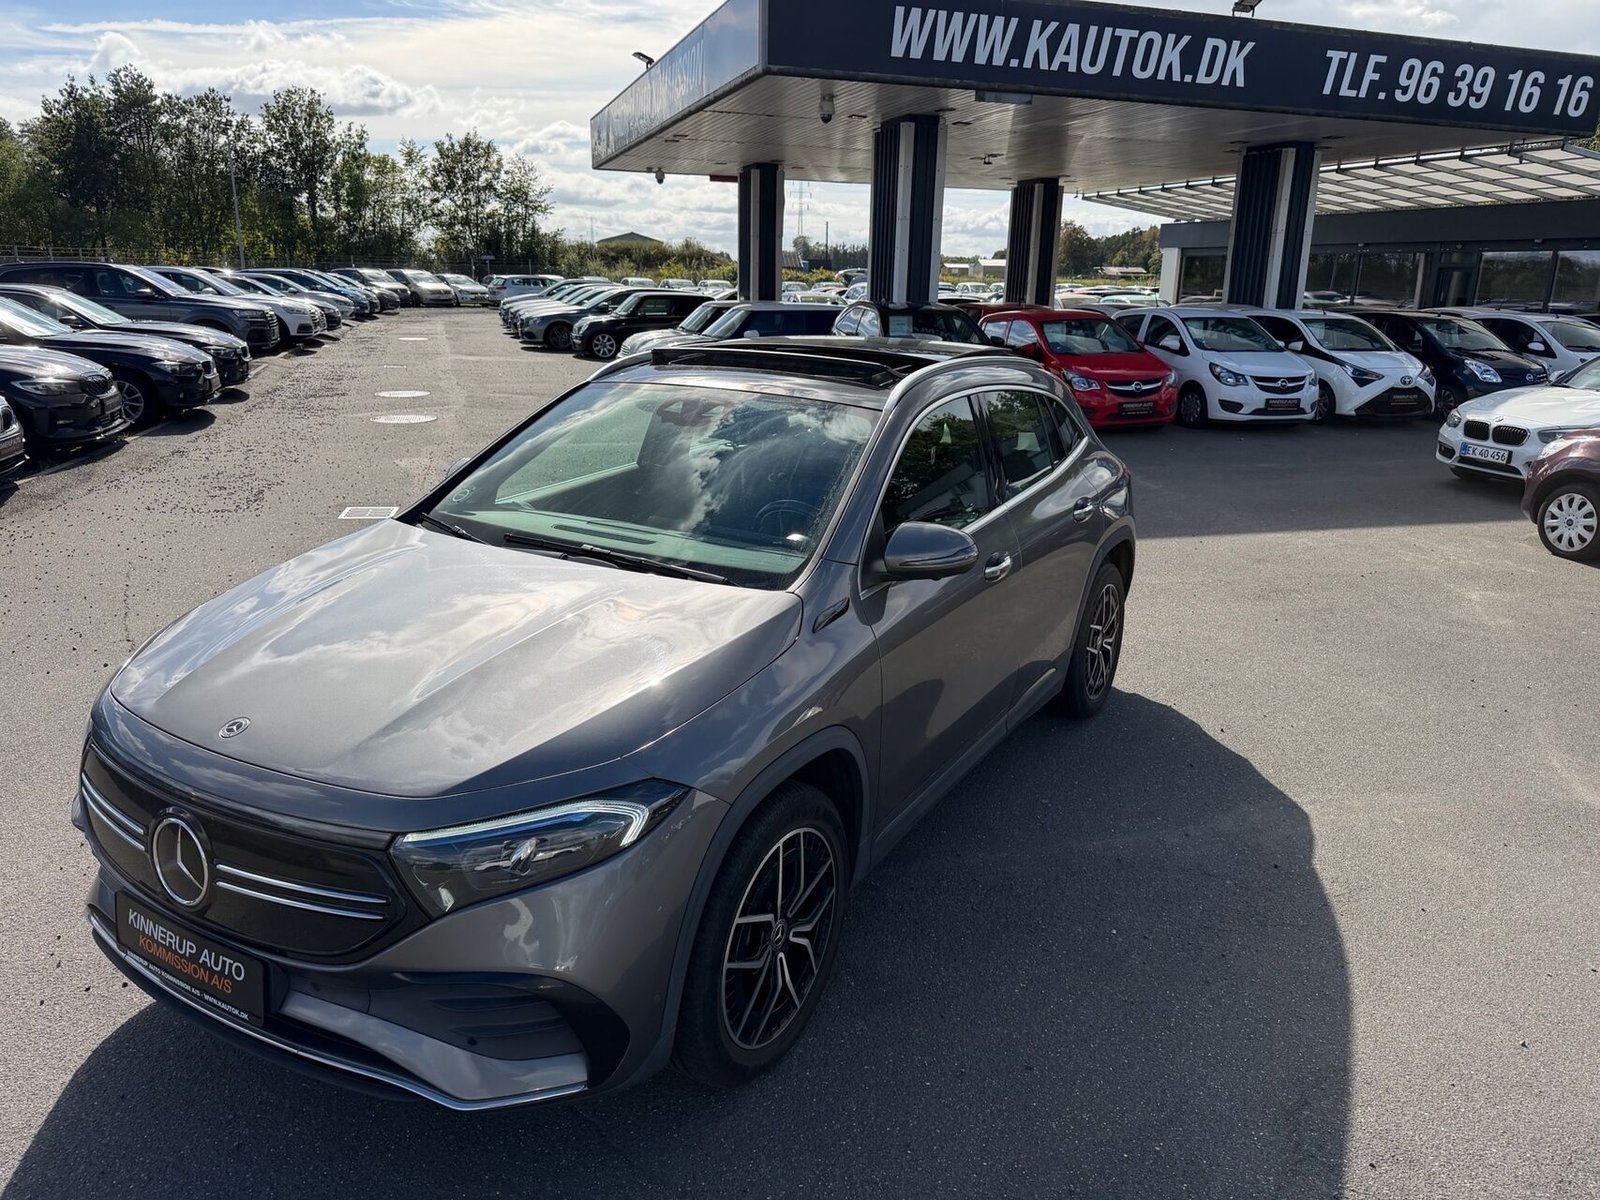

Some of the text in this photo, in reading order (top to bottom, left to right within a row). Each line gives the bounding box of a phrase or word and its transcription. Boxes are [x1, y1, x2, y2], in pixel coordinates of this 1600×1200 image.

[890, 5, 1256, 88] WWW.KAUTOK.DK
[1322, 49, 1594, 117] TLF. 96 39 16 16
[1466, 445, 1506, 462] EK 40 456
[128, 908, 245, 981] KINNERUP AUTO
[139, 935, 232, 994] KOMMISSION A/S
